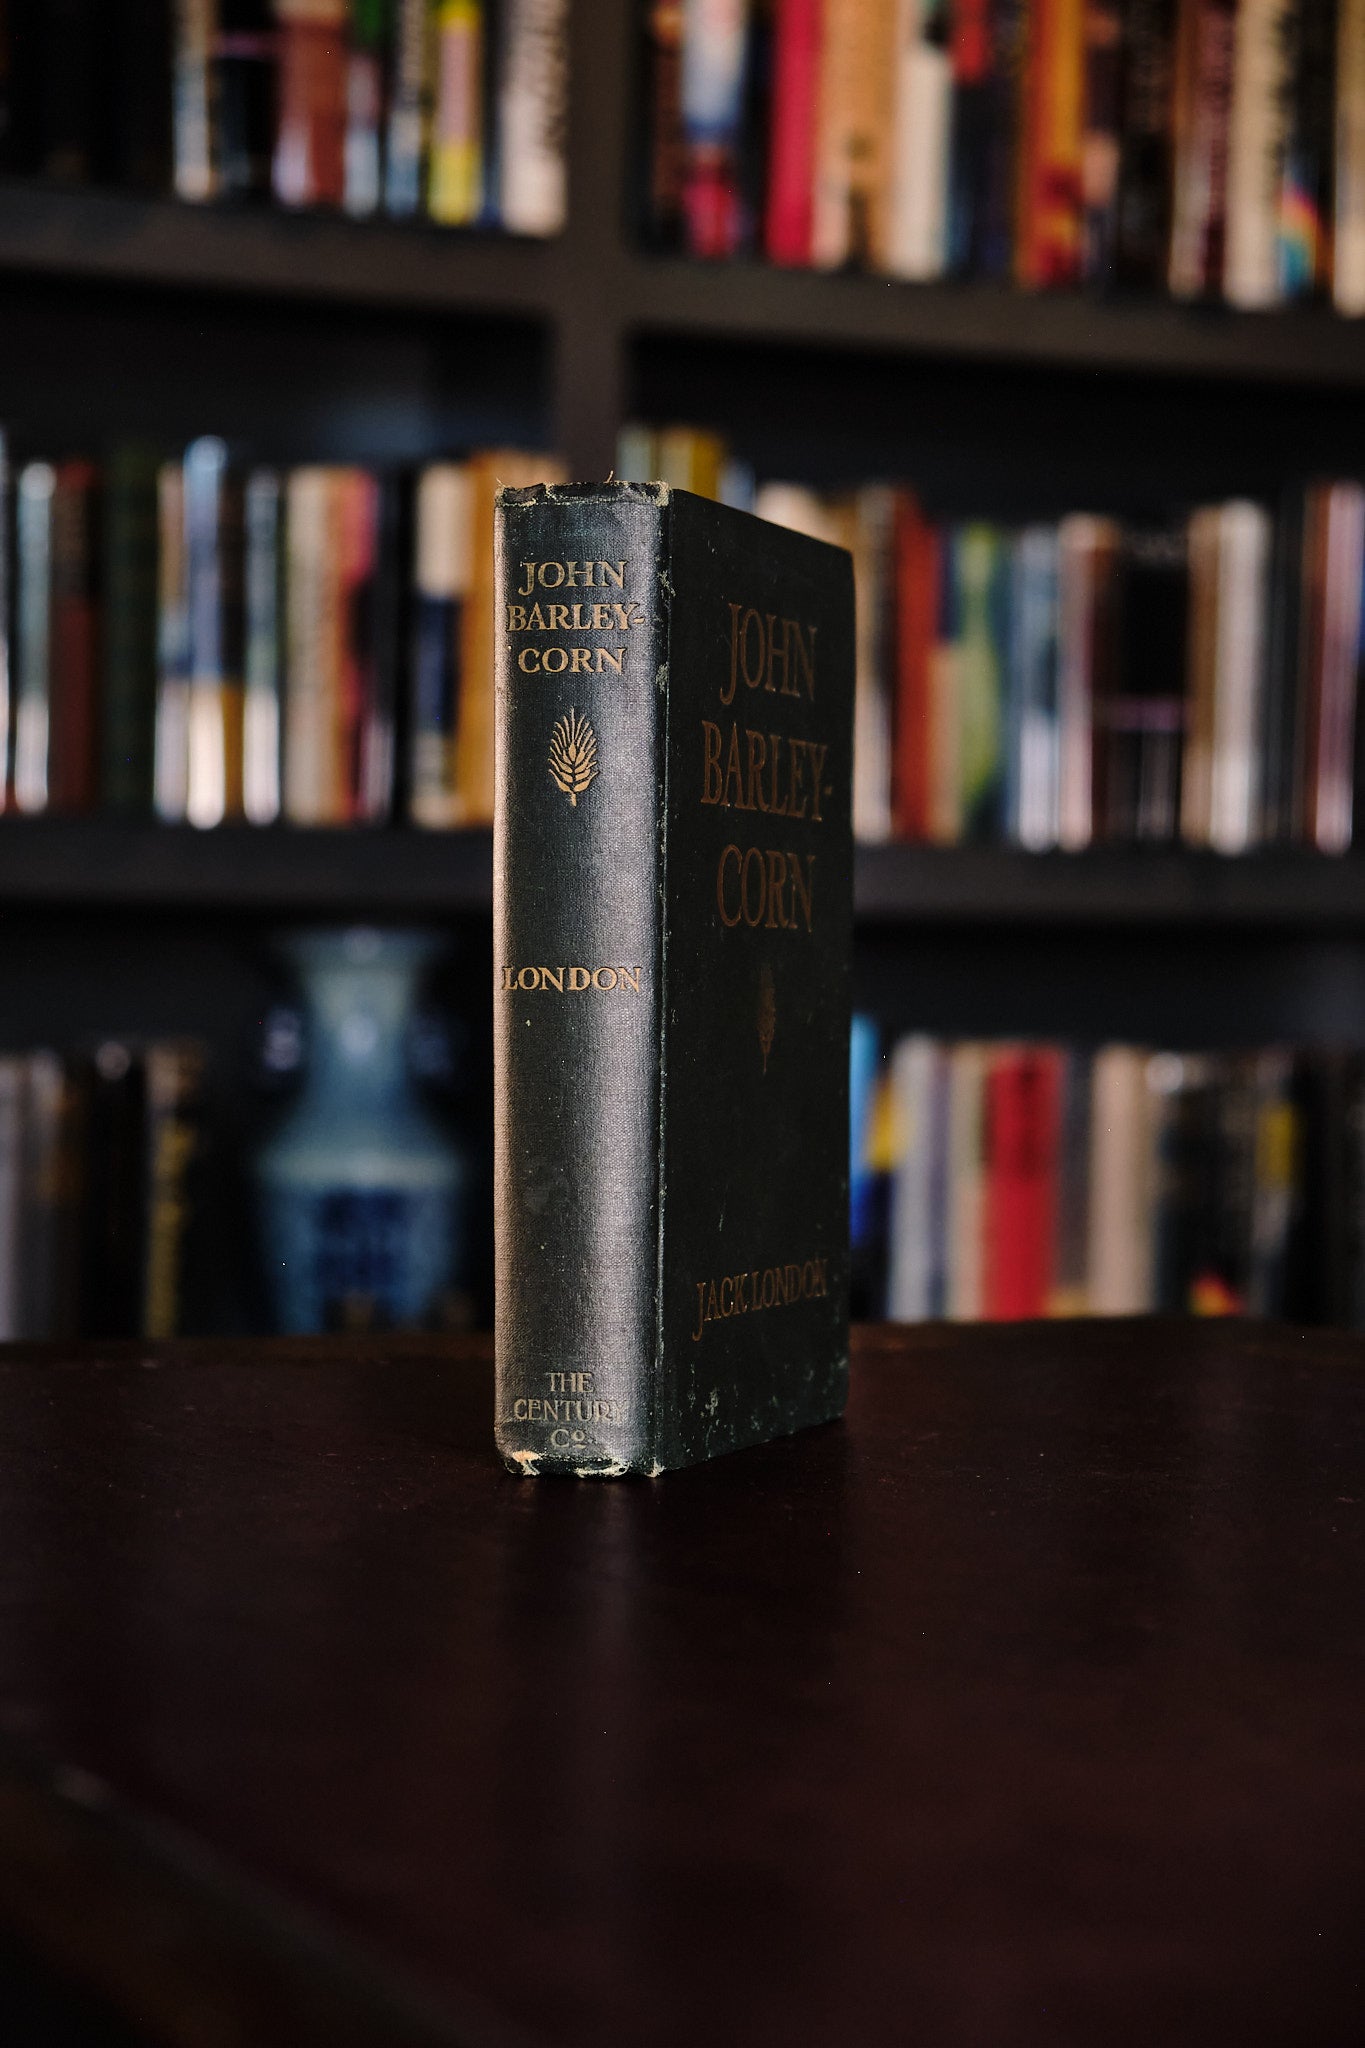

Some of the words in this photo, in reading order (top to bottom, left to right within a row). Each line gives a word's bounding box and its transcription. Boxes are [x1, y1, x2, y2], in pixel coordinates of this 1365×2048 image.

[518, 561, 628, 596] JOHN
[506, 602, 645, 632] BARLEY-
[518, 648, 626, 676] CORN
[720, 602, 817, 705] JOHN
[700, 719, 832, 822] BARLEY-
[716, 844, 815, 933] CORN
[502, 966, 642, 993] LONDON
[692, 1272, 748, 1341] JACK
[751, 1256, 828, 1311] LONDON
[547, 1372, 594, 1393] THE
[513, 1398, 627, 1422] CENTURY
